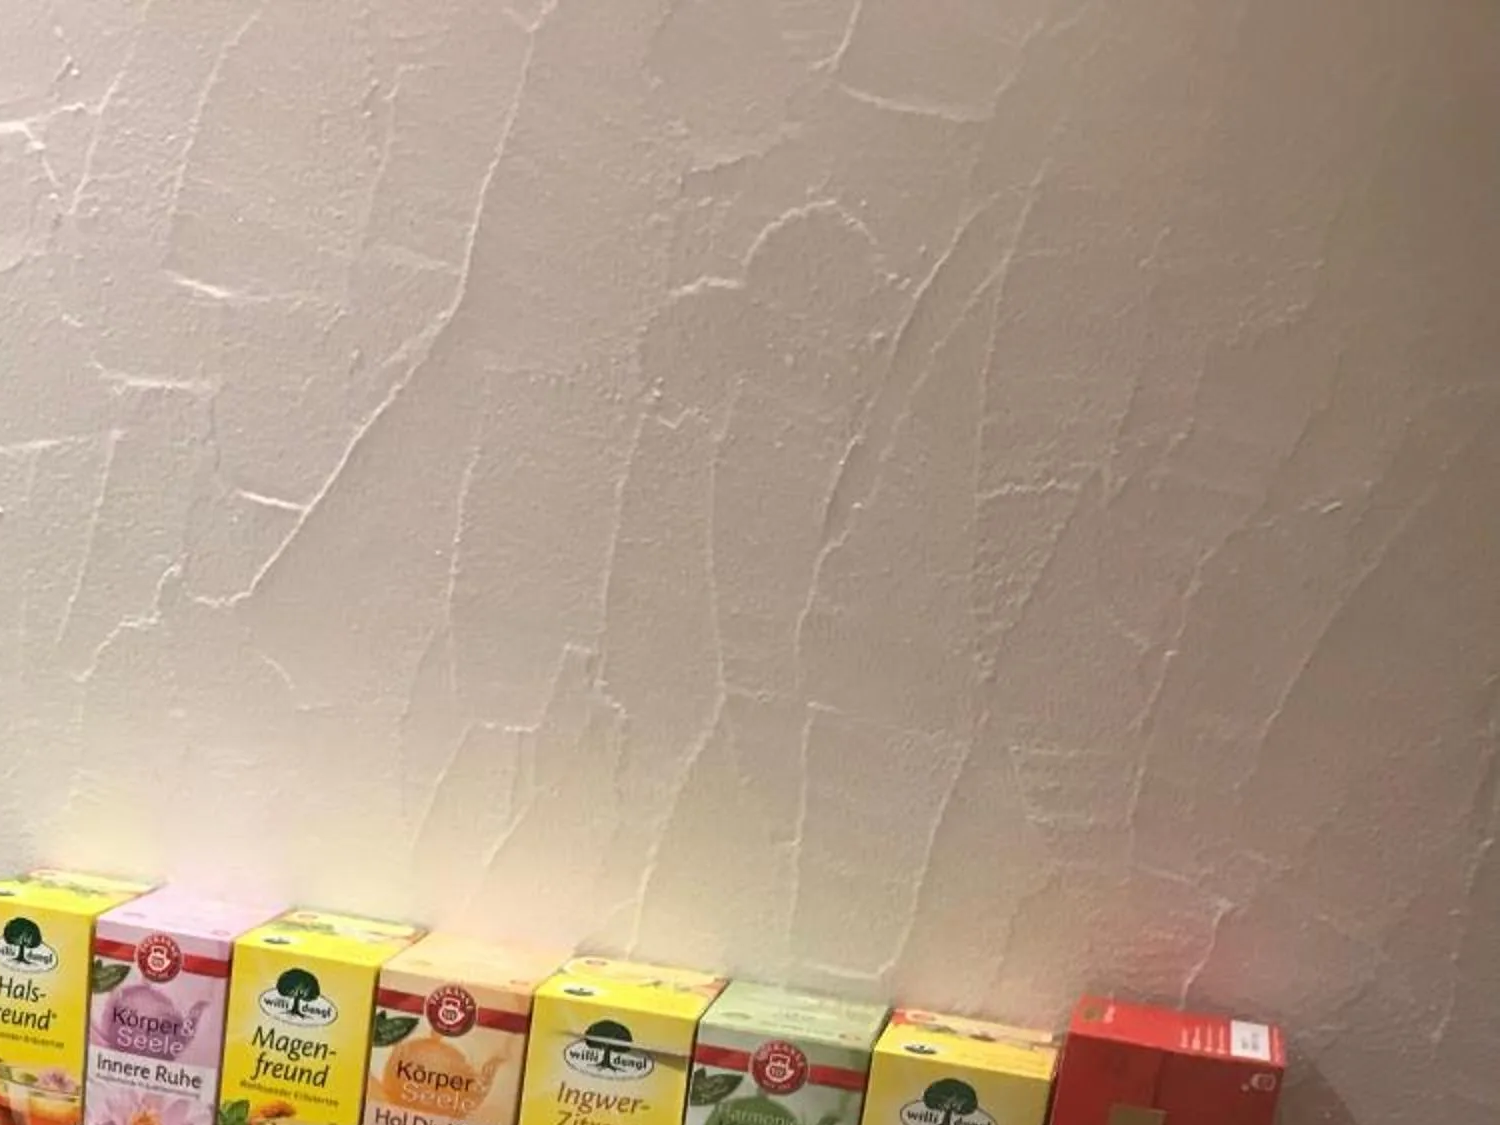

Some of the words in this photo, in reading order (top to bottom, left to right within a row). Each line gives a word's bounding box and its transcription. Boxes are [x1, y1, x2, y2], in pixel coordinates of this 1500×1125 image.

[117, 1026, 184, 1056] Seele
[251, 1025, 338, 1061] Magen-
[569, 1049, 598, 1063] willi
[97, 1053, 150, 1079] Innere
[155, 1065, 203, 1089] Ruhe
[250, 1052, 330, 1088] freund
[557, 1080, 651, 1115] Ingwer-
